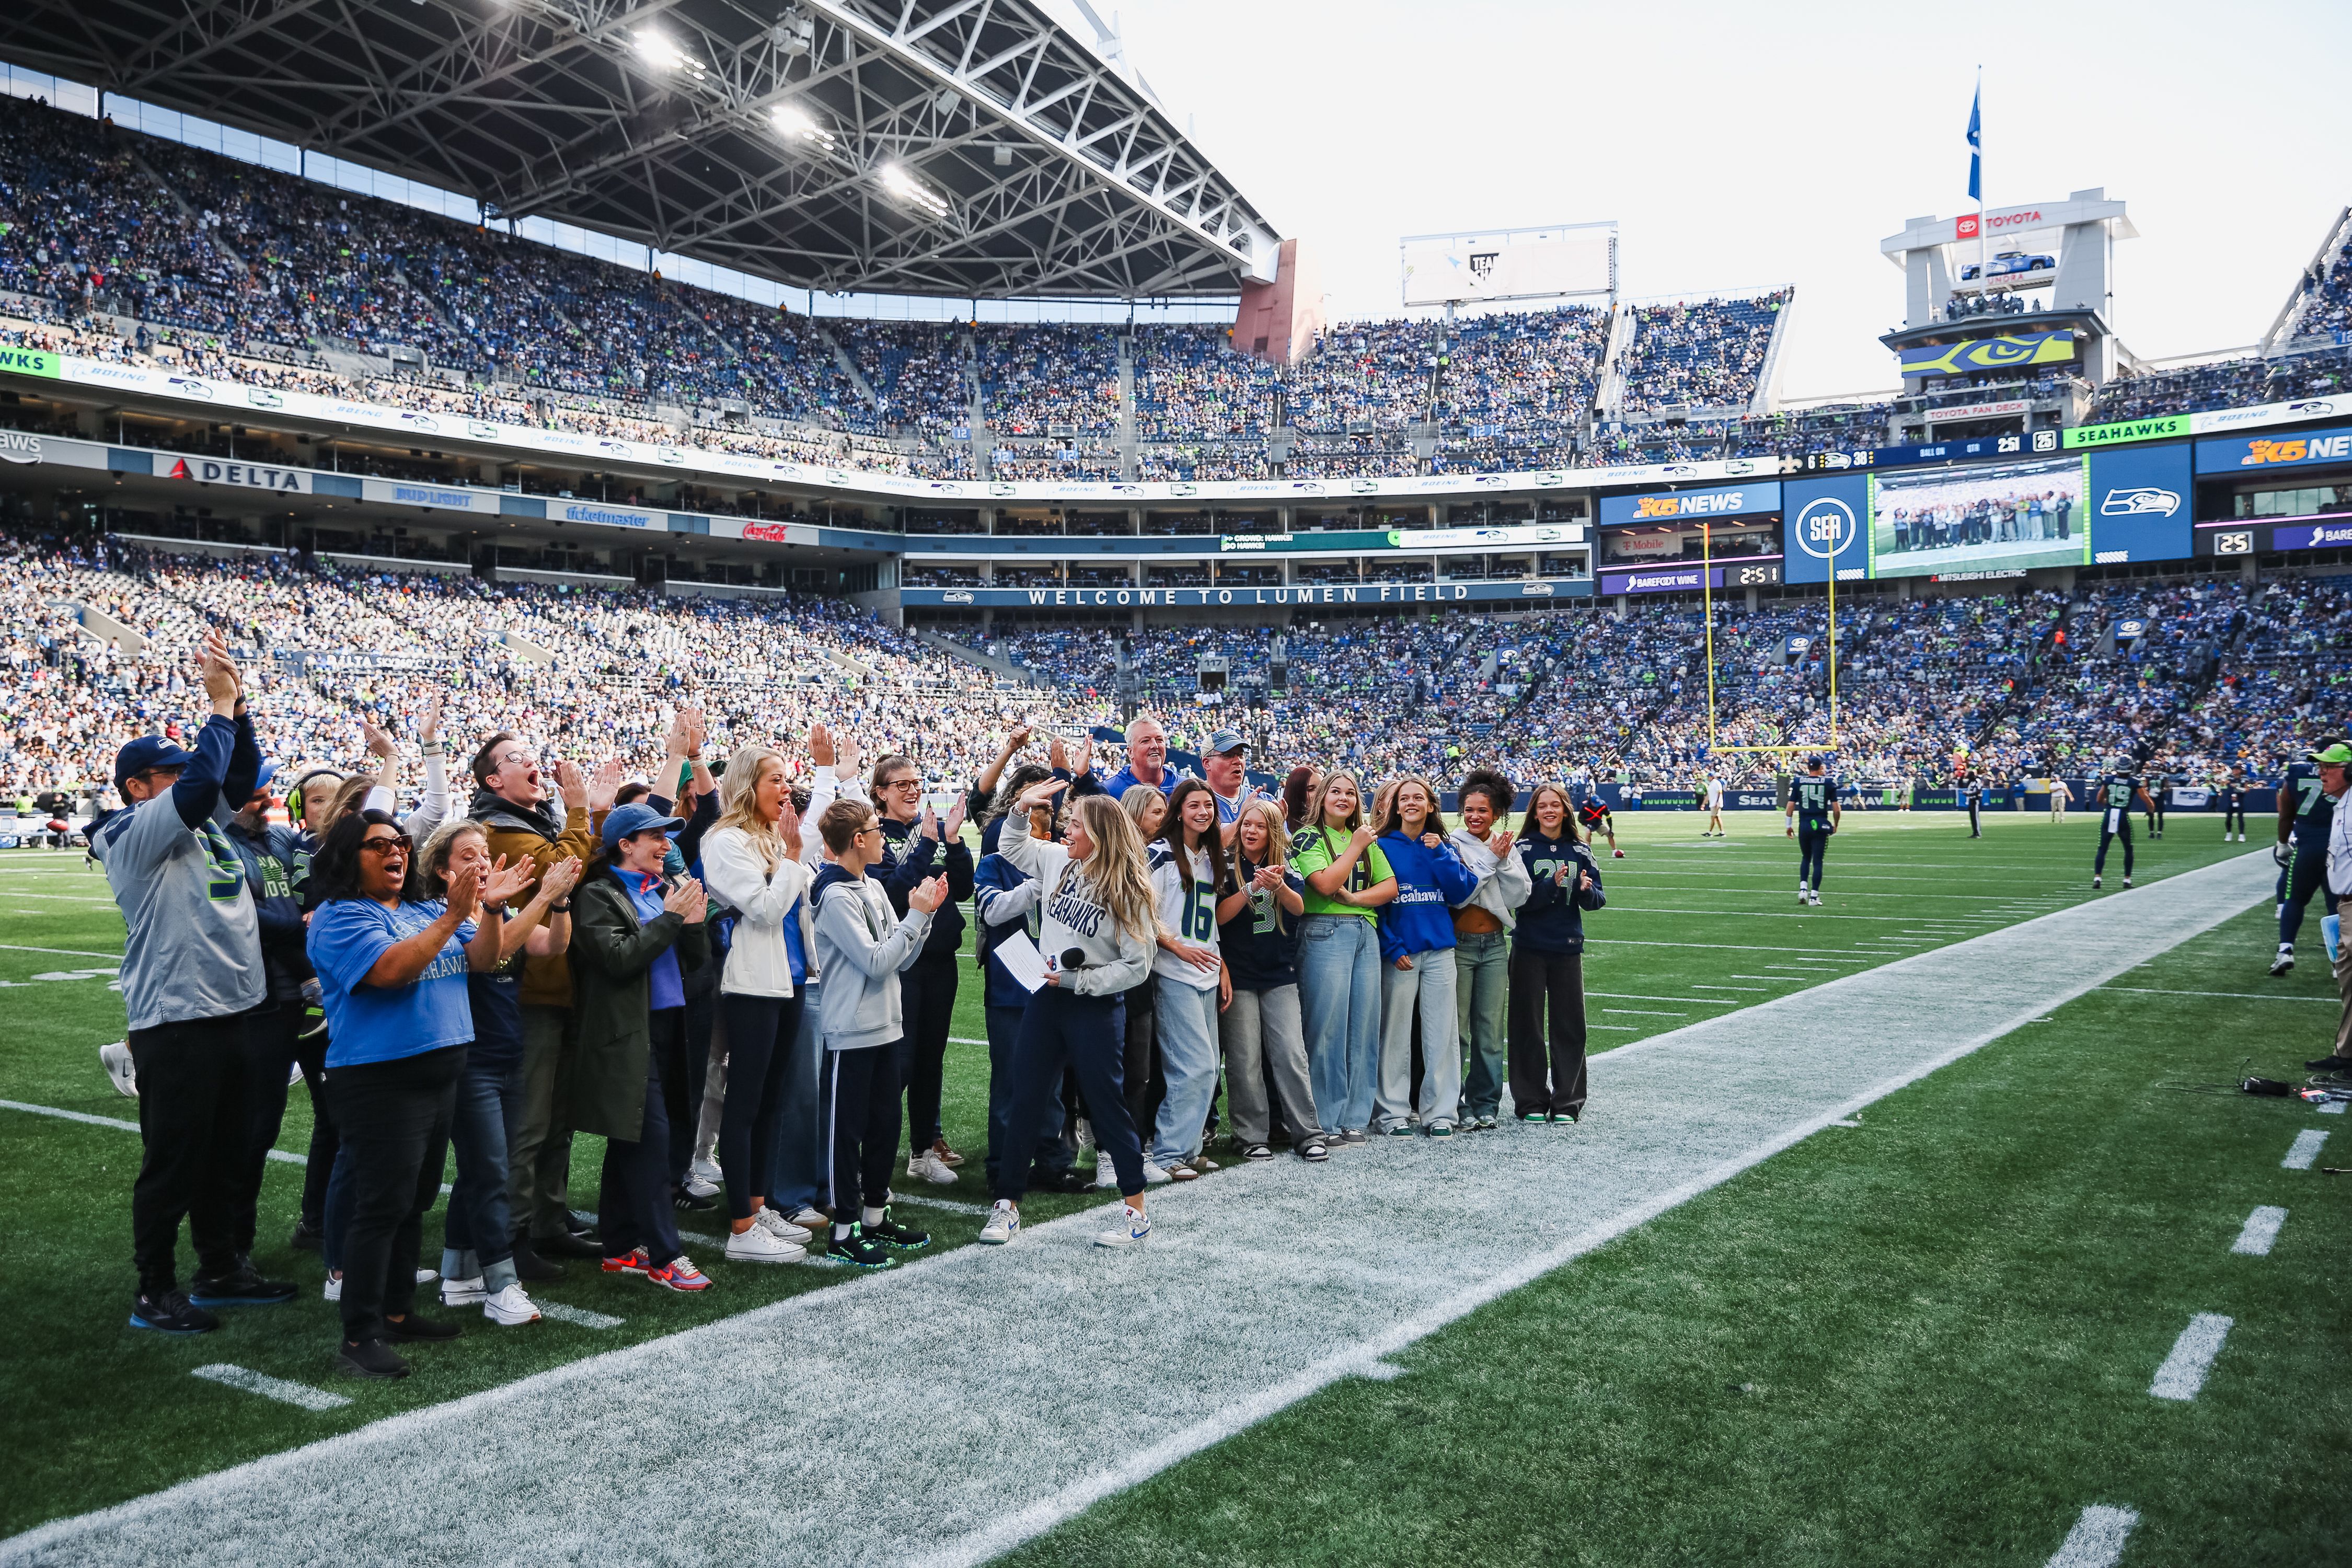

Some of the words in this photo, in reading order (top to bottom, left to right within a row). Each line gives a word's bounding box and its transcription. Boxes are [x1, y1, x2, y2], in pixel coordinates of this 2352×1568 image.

[1986, 211, 2042, 228] TOYOTA
[1987, 272, 2024, 284] UNDRA
[0, 352, 44, 370] WKS
[91, 367, 146, 382] BOEING
[337, 406, 383, 418] BOEING
[1930, 408, 1970, 418] TOYOTA
[1973, 405, 1992, 415] FAN
[1996, 401, 2024, 413] DECK
[2218, 410, 2268, 422] BOEING
[957, 429, 967, 438] 12
[2077, 420, 2178, 443] SEAHAWKS
[544, 436, 586, 446] BOEING
[1998, 436, 2020, 453] 2:51
[2037, 434, 2053, 448] 25
[2308, 435, 2352, 459] NE
[1062, 450, 1075, 462] 12
[1807, 454, 1815, 470] 6
[1853, 451, 1868, 466] 38
[203, 462, 299, 490] DELTA
[396, 487, 427, 502] BUD
[429, 491, 471, 507] LIGHT
[1679, 491, 1744, 515] NEWS
[566, 505, 650, 527] ticketmaster
[1809, 514, 1841, 541] SEA
[2325, 528, 2352, 541] BARE
[1633, 538, 1664, 550] Mobile
[2220, 533, 2248, 553] 25
[1636, 576, 1676, 589] BAREFOOT
[1676, 574, 1698, 585] WINE
[1985, 568, 2027, 579] ELECTRIC
[1029, 590, 1177, 605] WELCOME
[1198, 589, 1232, 605] TO
[1256, 588, 1357, 604] LUMEN
[1380, 585, 1467, 602] FIELD
[1047, 725, 1089, 736] LUMEN
[1738, 794, 1778, 805] SEAT
[1800, 785, 1824, 809] 14
[2107, 784, 2131, 808] 19
[1392, 888, 1445, 904] Seahawk
[1047, 892, 1106, 939] SEAHAWKS
